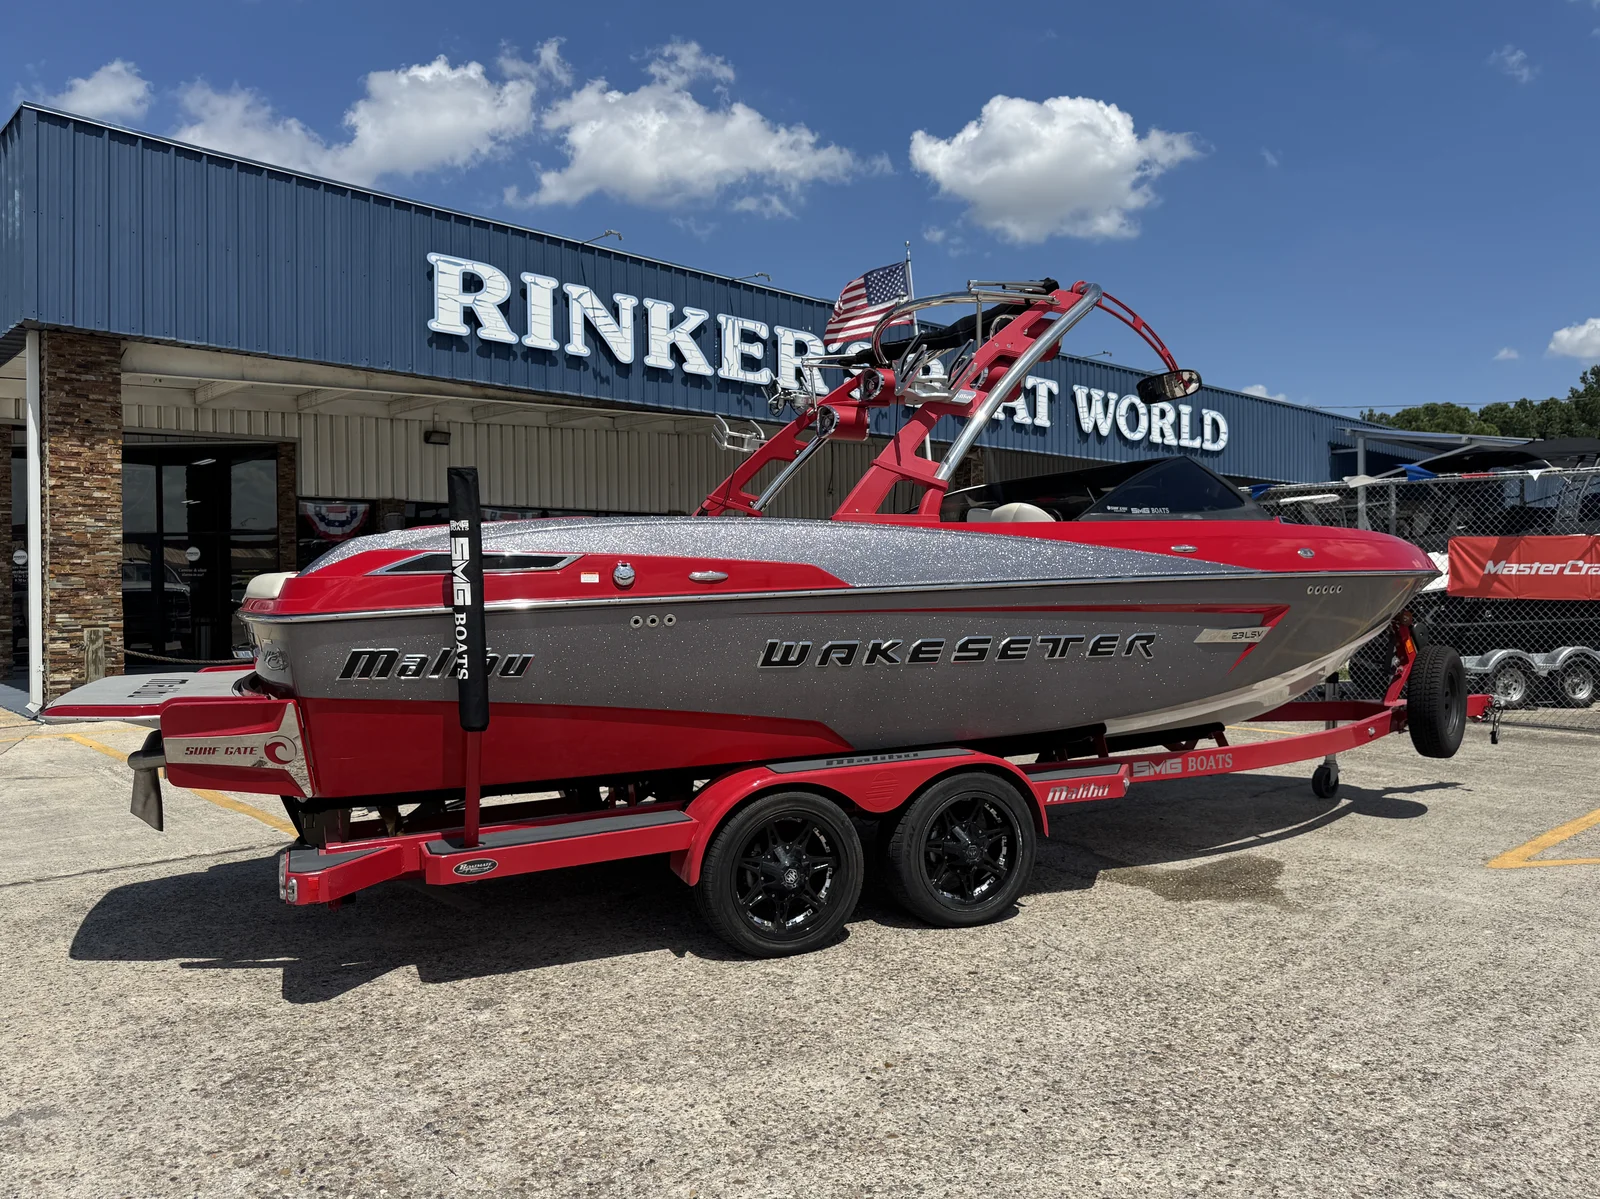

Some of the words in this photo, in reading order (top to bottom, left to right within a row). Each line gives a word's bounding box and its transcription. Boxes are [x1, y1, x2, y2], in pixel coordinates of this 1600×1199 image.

[1073, 384, 1228, 451] WORLD
[450, 537, 472, 606] SMG
[454, 612, 469, 680] BOATS
[757, 632, 1157, 669] WAKESETTER
[1231, 630, 1264, 640] 23LSV
[185, 746, 221, 756] SURF
[224, 746, 259, 756] GATE
[1132, 757, 1183, 778] SMG
[1187, 753, 1233, 772] BOATS
[1046, 782, 1111, 802] Malibu
